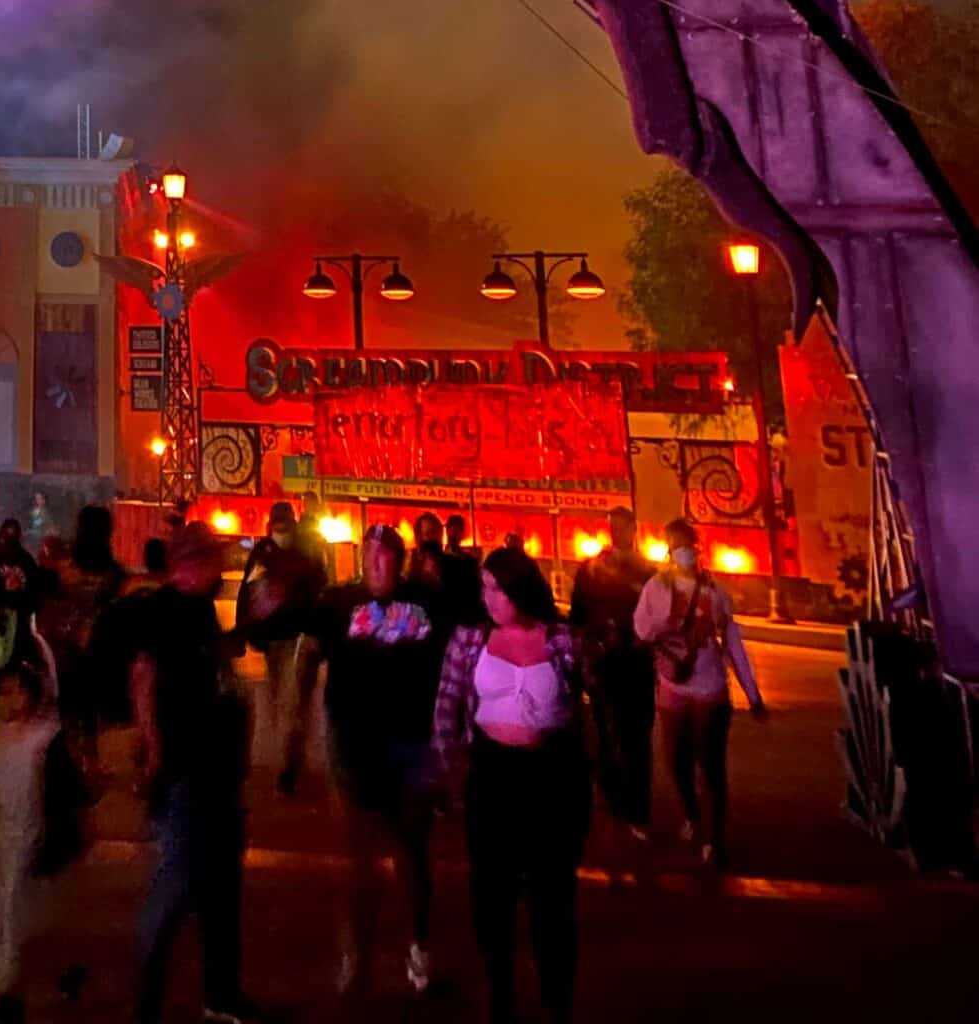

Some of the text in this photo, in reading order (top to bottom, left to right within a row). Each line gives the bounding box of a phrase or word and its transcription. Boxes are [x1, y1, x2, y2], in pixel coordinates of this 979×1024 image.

[325, 482, 348, 492] THE
[357, 484, 411, 496] FUTURE
[417, 488, 447, 497] HAD
[453, 490, 534, 504] HAPPENED
[542, 495, 608, 507] SOONER
